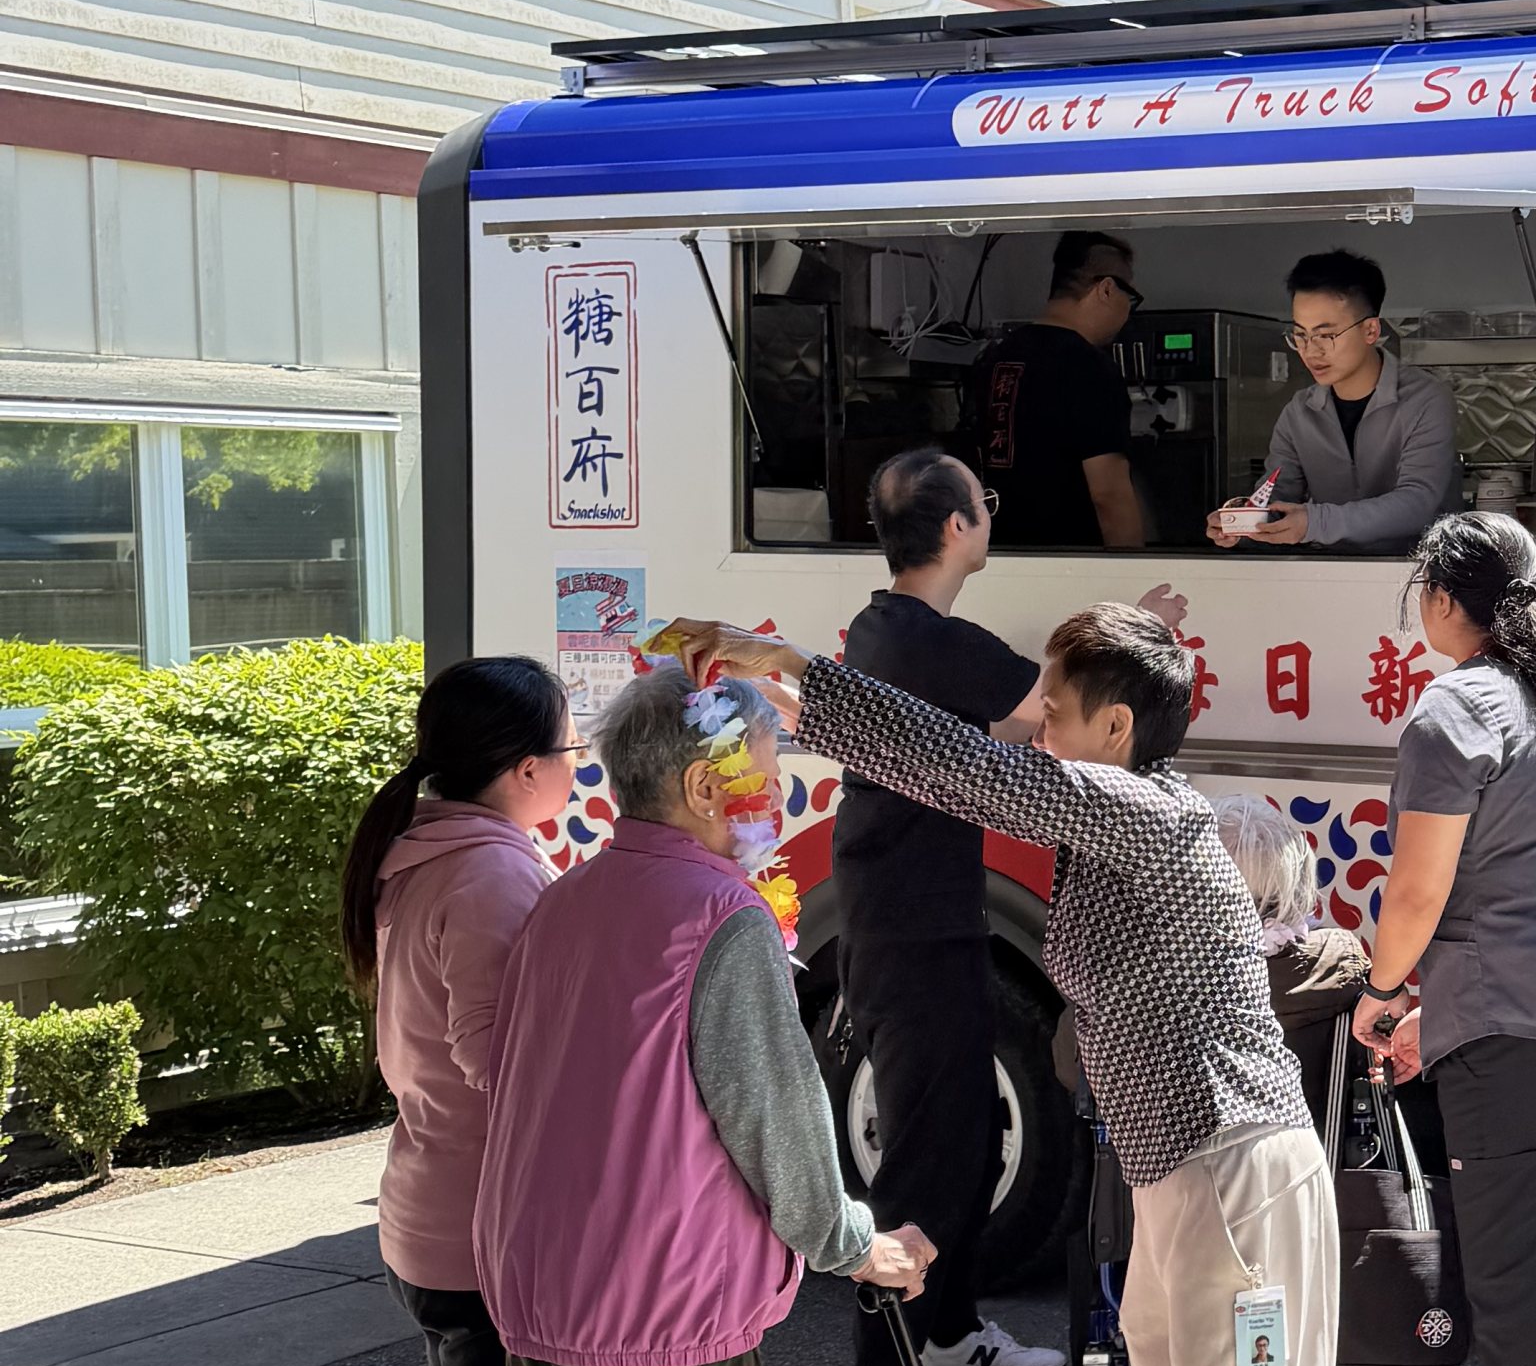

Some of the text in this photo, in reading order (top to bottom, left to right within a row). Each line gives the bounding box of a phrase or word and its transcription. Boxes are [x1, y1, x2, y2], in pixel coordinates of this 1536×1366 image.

[974, 93, 1107, 137] Watt
[1134, 81, 1188, 128] A
[1215, 67, 1376, 123] Truck
[562, 288, 623, 498] 糖百府
